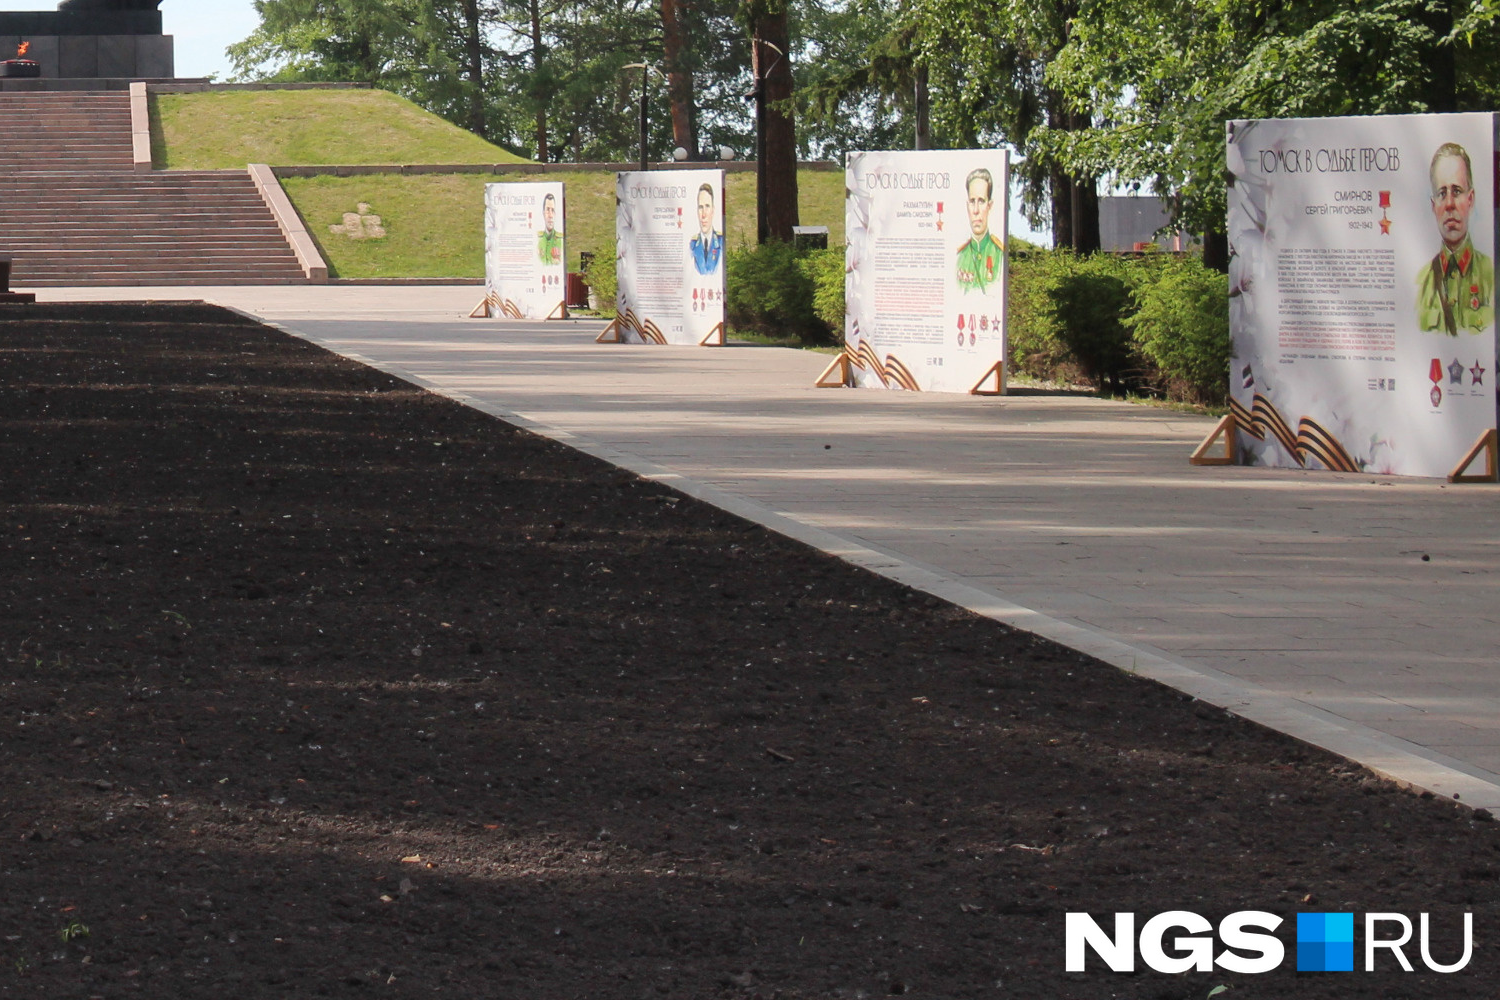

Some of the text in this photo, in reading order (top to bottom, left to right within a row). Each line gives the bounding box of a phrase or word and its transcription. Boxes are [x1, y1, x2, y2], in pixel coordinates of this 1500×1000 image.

[1259, 147, 1400, 173] ТОМСК В СУДЬБЕ ГЕРОЕВ
[866, 173, 891, 190] ТОМСК
[893, 173, 898, 189] В
[1334, 191, 1372, 201] СМИРНОВ
[1305, 203, 1372, 215] СЕРГЕЙ ГРИГОРЬЕВИЧ
